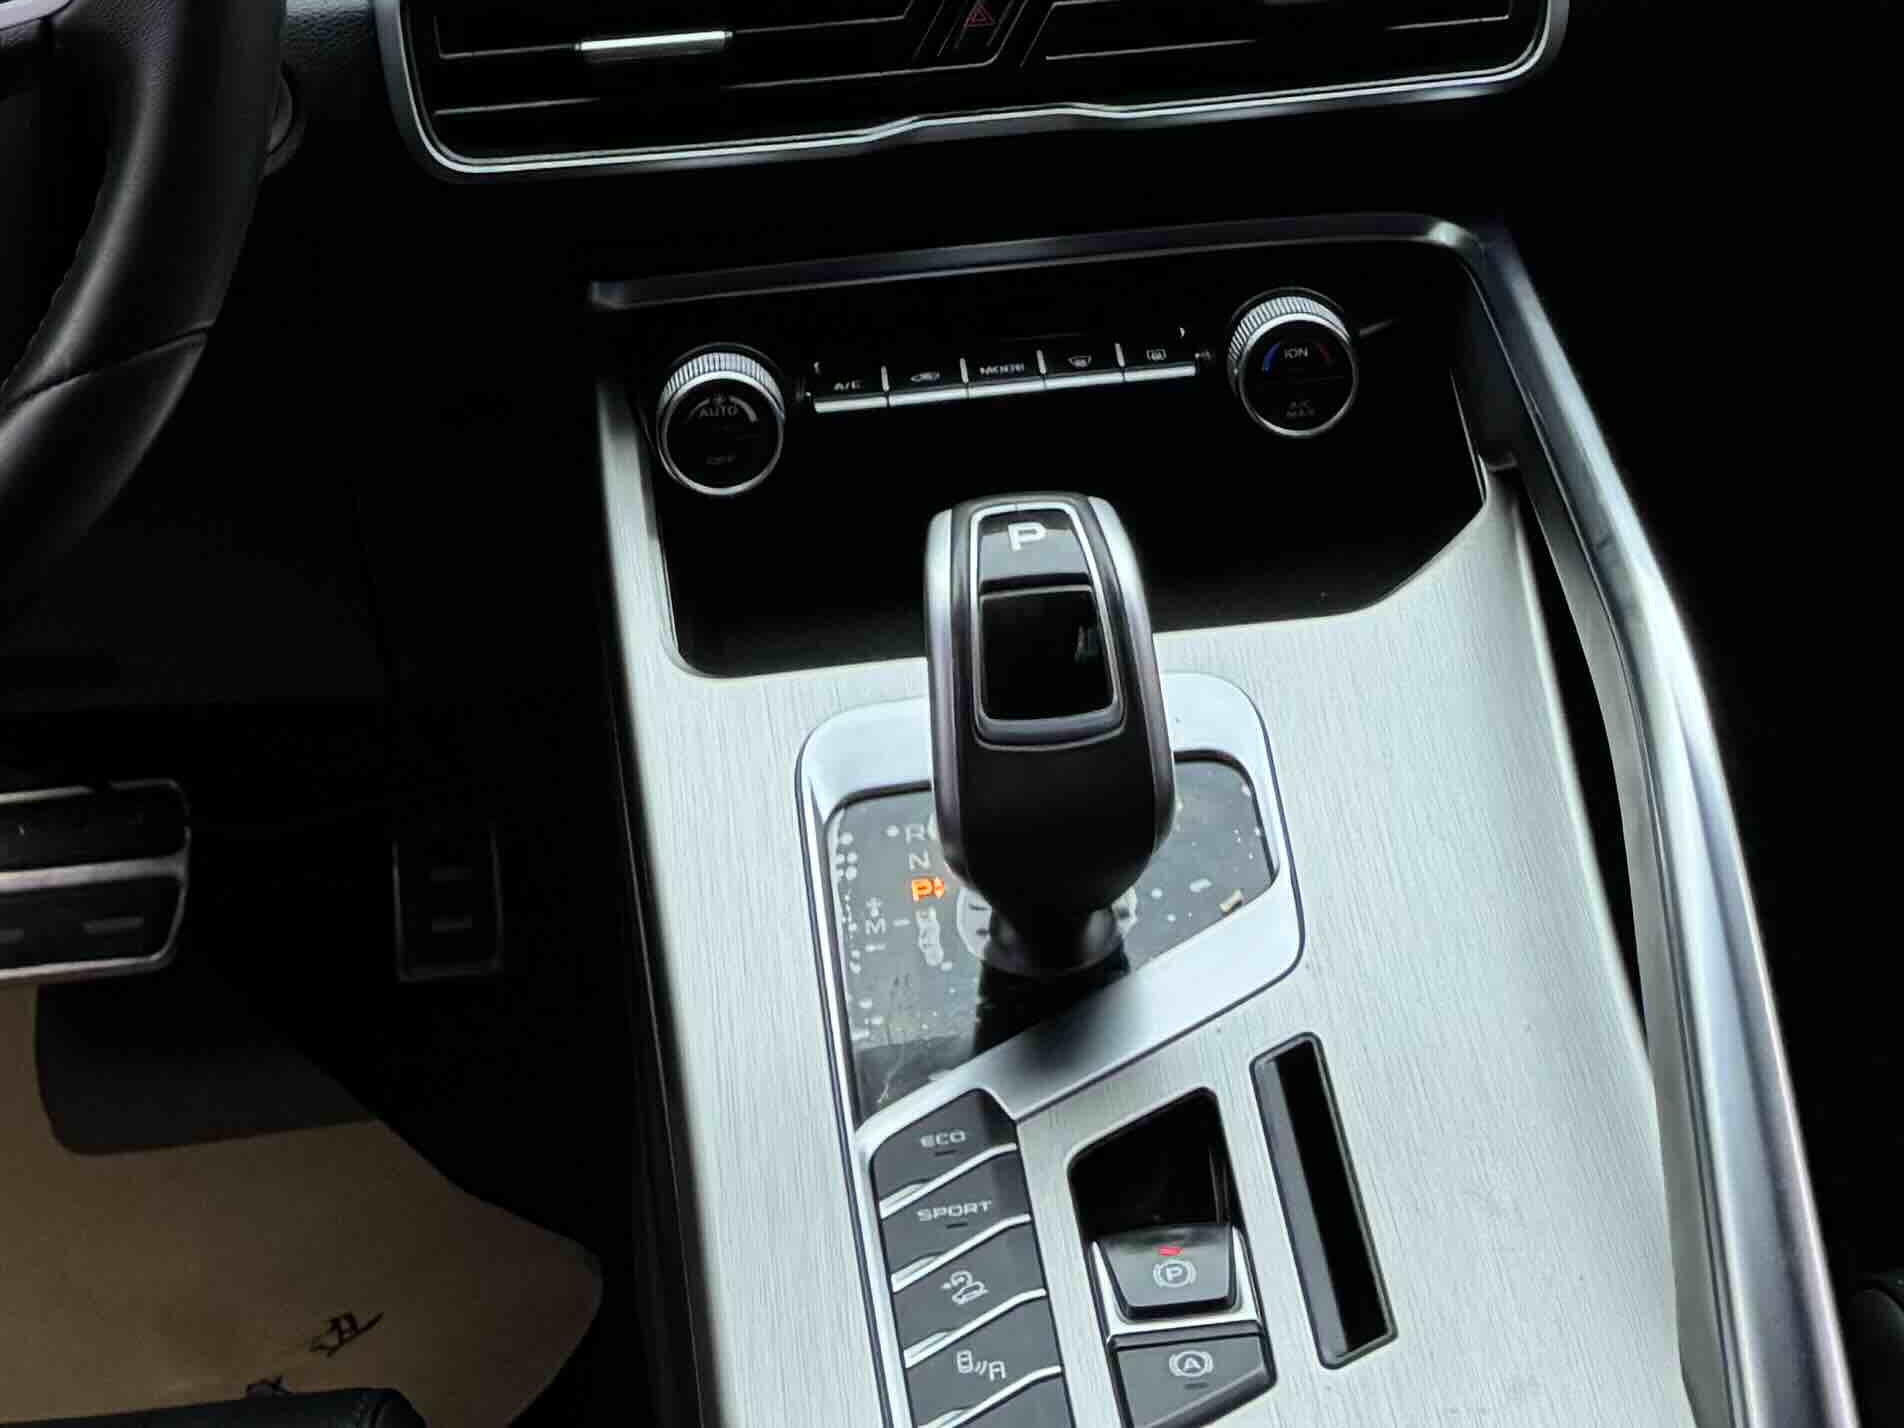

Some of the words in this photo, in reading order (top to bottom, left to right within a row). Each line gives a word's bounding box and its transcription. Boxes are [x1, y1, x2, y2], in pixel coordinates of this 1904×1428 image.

[1283, 346, 1309, 359] ION
[699, 404, 739, 418] AUTO
[1007, 520, 1046, 551] P
[905, 824, 925, 844] R
[908, 850, 930, 871] N
[865, 919, 886, 935] M
[919, 1130, 967, 1148] ECO
[917, 1199, 993, 1222] SPORT
